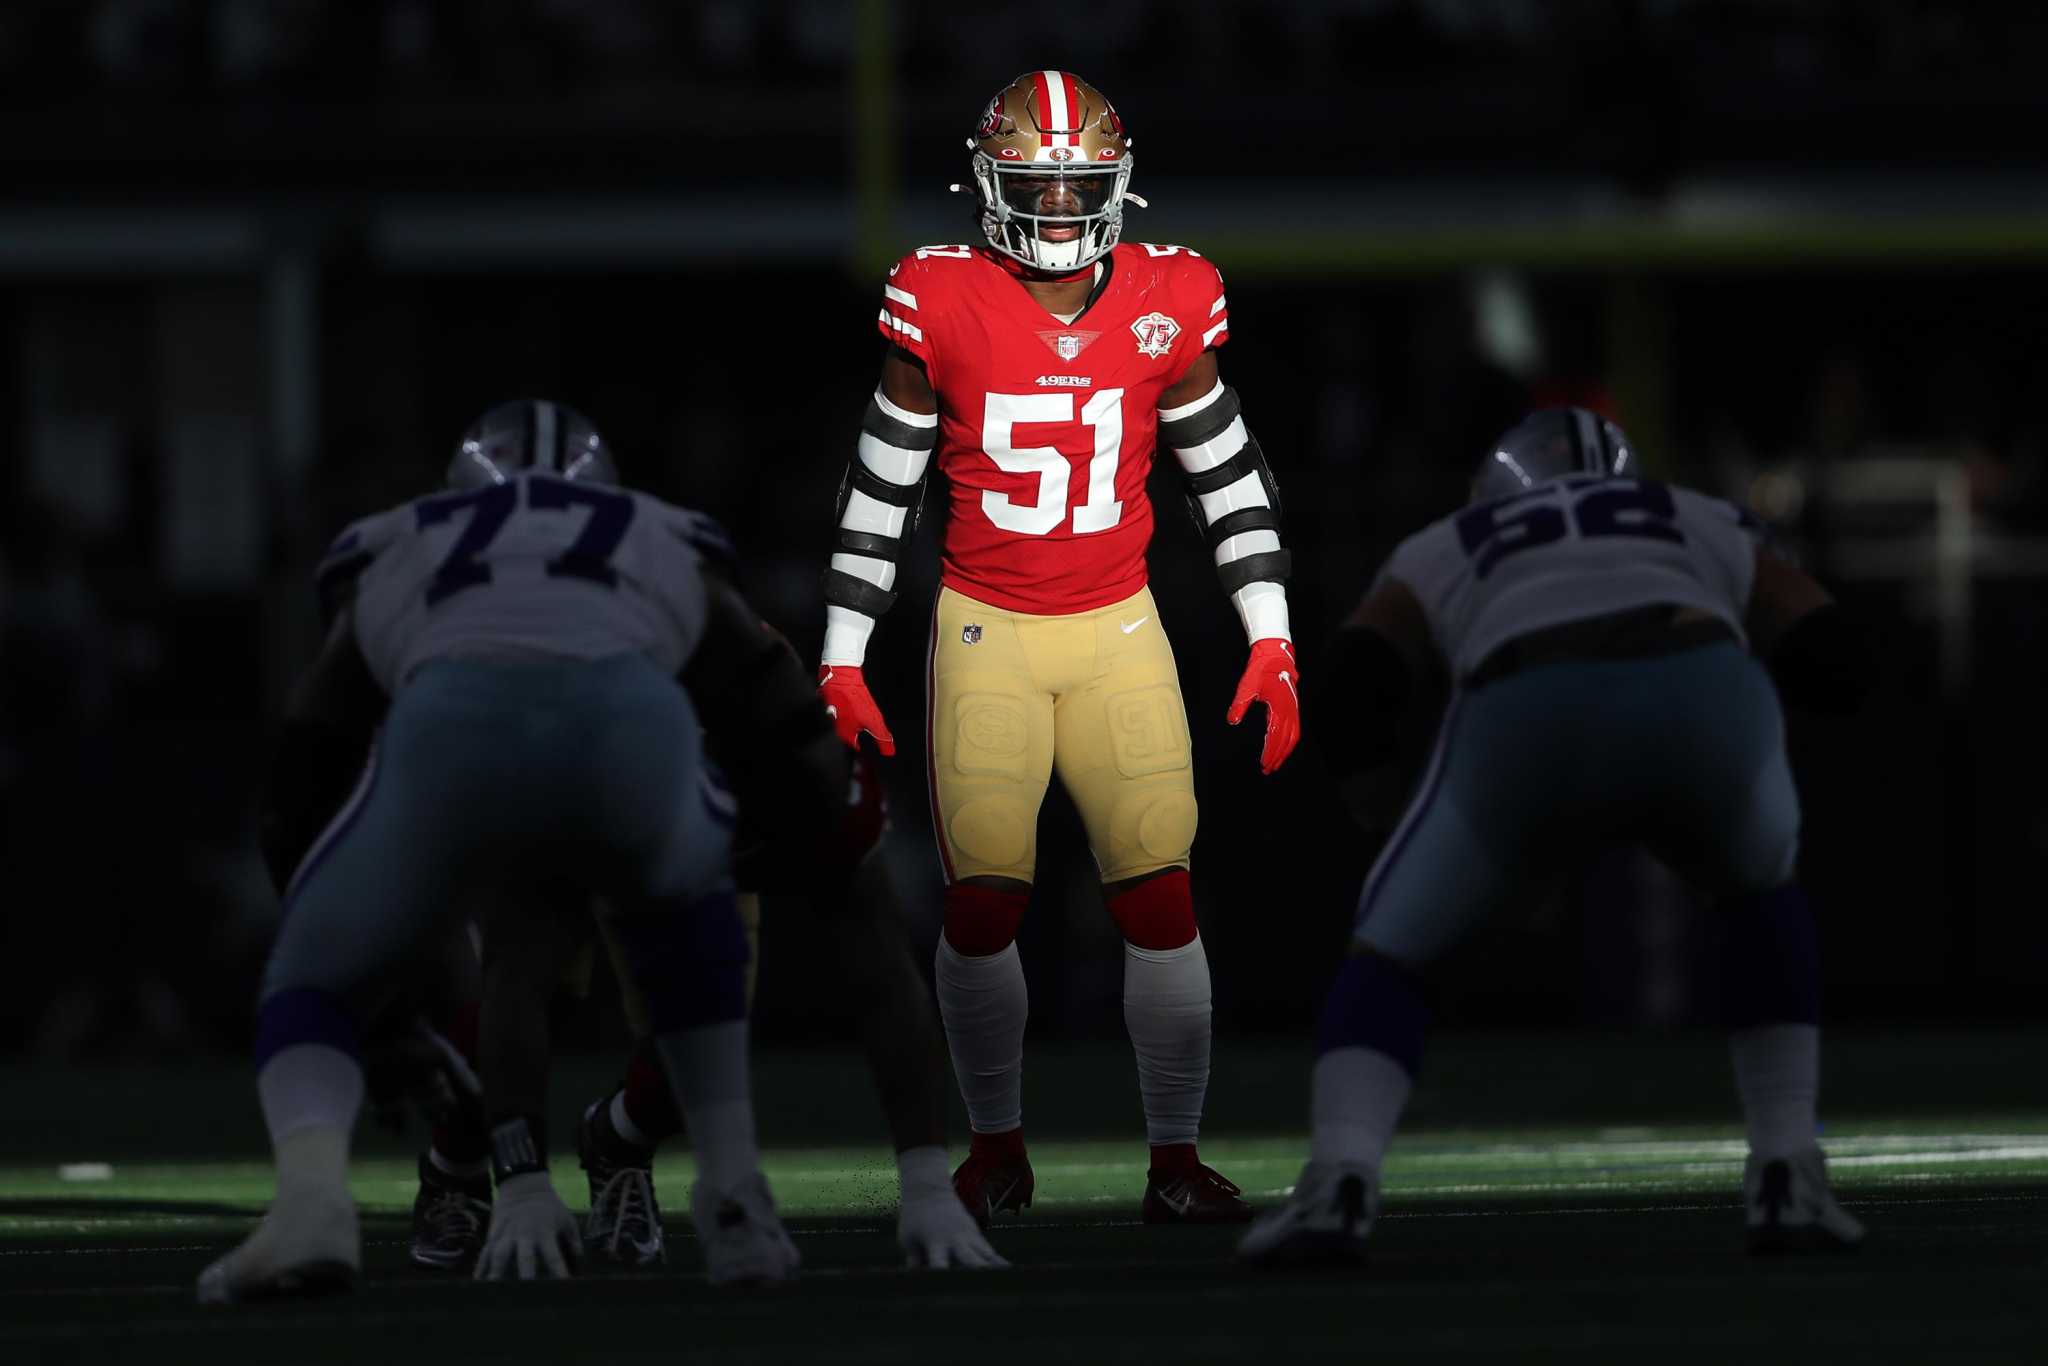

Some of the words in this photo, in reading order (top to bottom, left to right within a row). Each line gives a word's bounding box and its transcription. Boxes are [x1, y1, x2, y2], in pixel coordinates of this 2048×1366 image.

[1143, 322, 1170, 345] 75
[1035, 375, 1092, 387] 49ERS
[981, 387, 1124, 536] 51
[415, 477, 633, 608] 77
[1457, 478, 1686, 579] 52
[1118, 698, 1180, 758] 51
